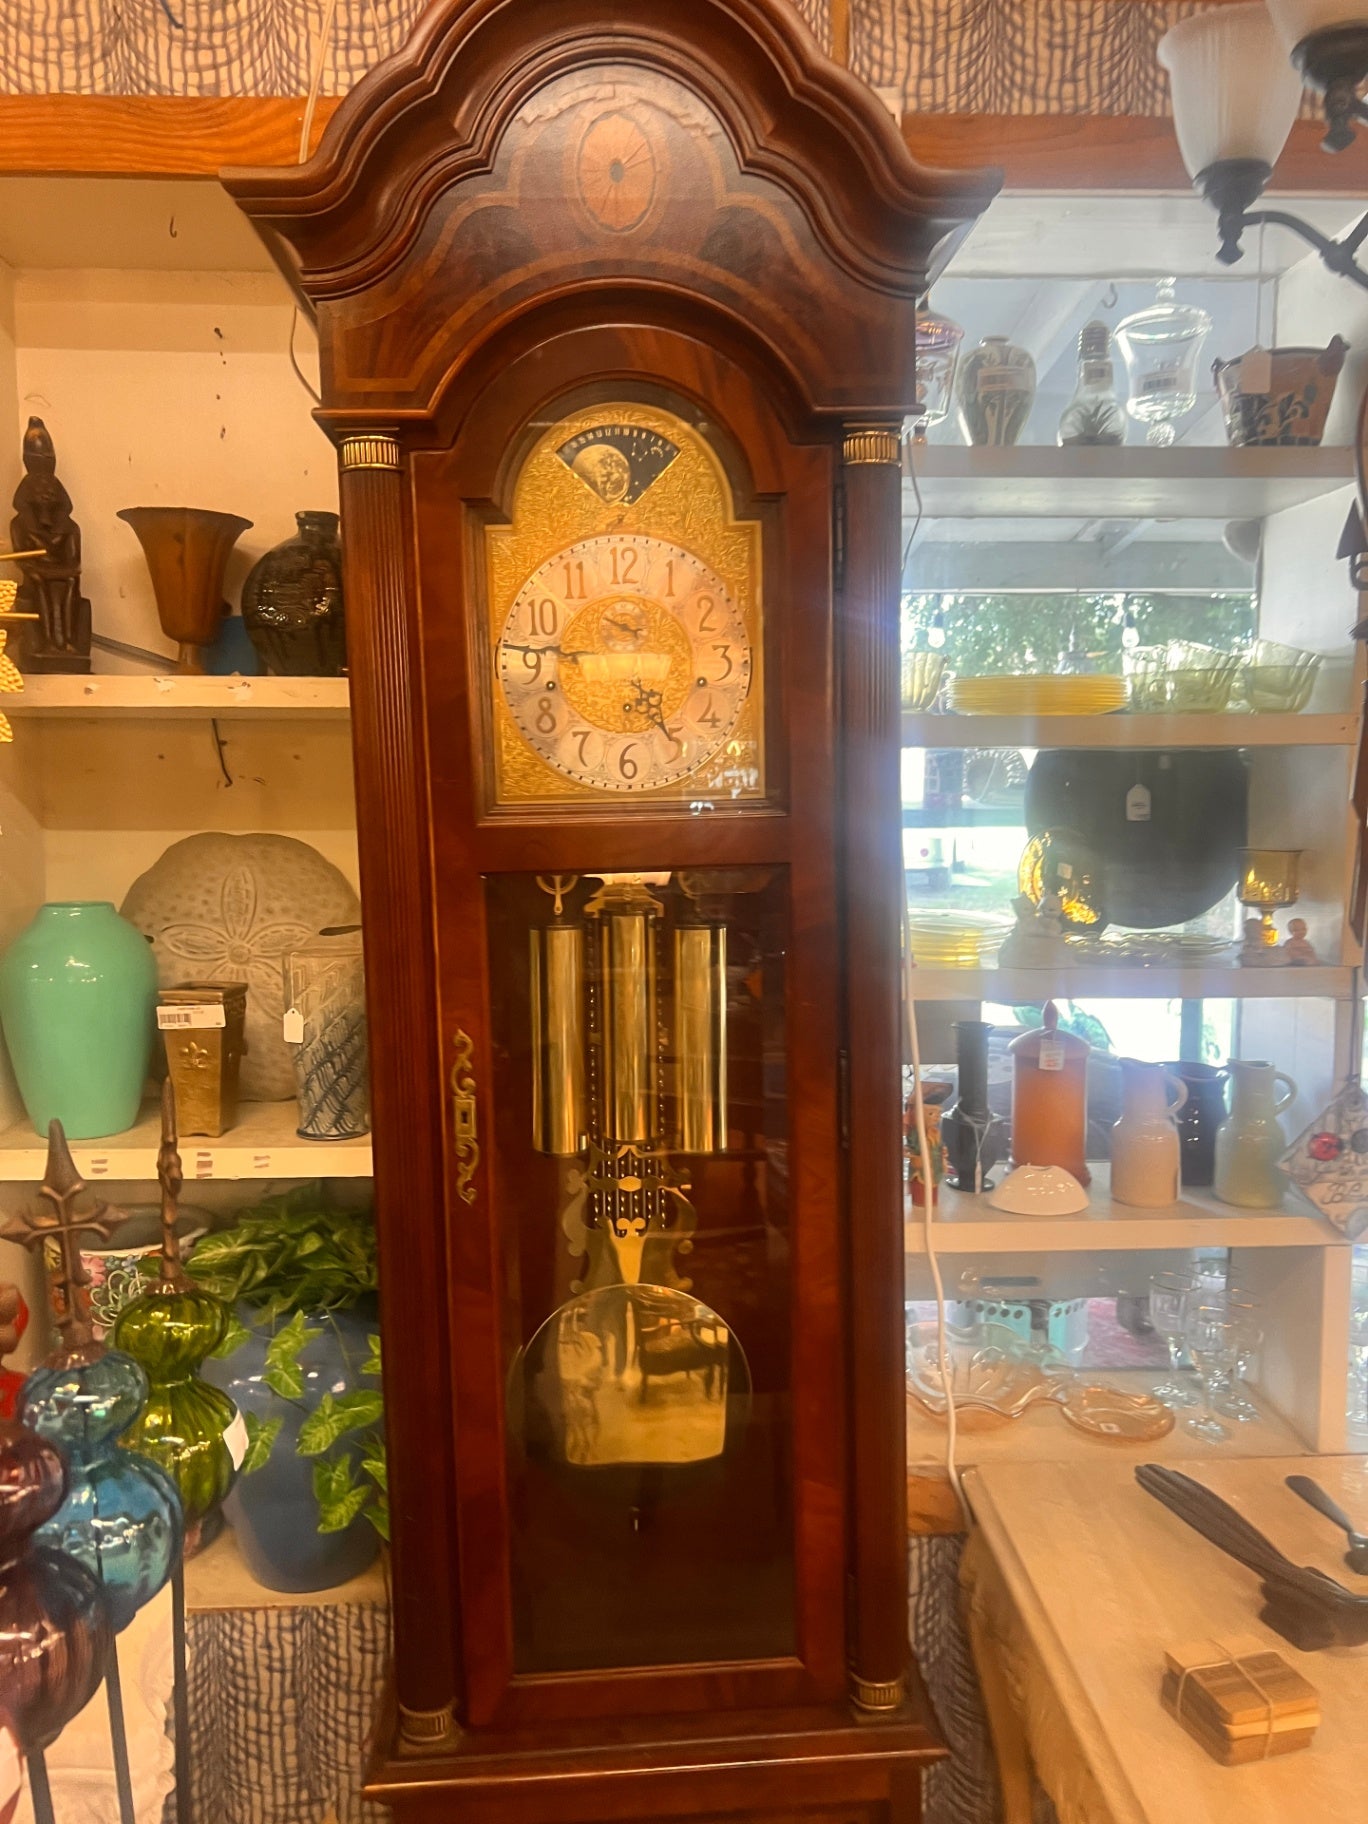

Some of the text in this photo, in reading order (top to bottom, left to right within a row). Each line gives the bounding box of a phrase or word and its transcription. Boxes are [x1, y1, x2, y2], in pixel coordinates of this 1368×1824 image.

[563, 561, 588, 599] 11
[609, 546, 639, 585] 12
[665, 560, 676, 597] 1
[528, 599, 558, 636] 10
[697, 595, 718, 632] 2
[521, 650, 542, 685] 9
[711, 644, 733, 682] 3
[536, 697, 556, 734] 8
[696, 693, 721, 729] 4
[571, 731, 592, 767] 7
[619, 743, 638, 780] 6
[664, 726, 684, 764] 5
